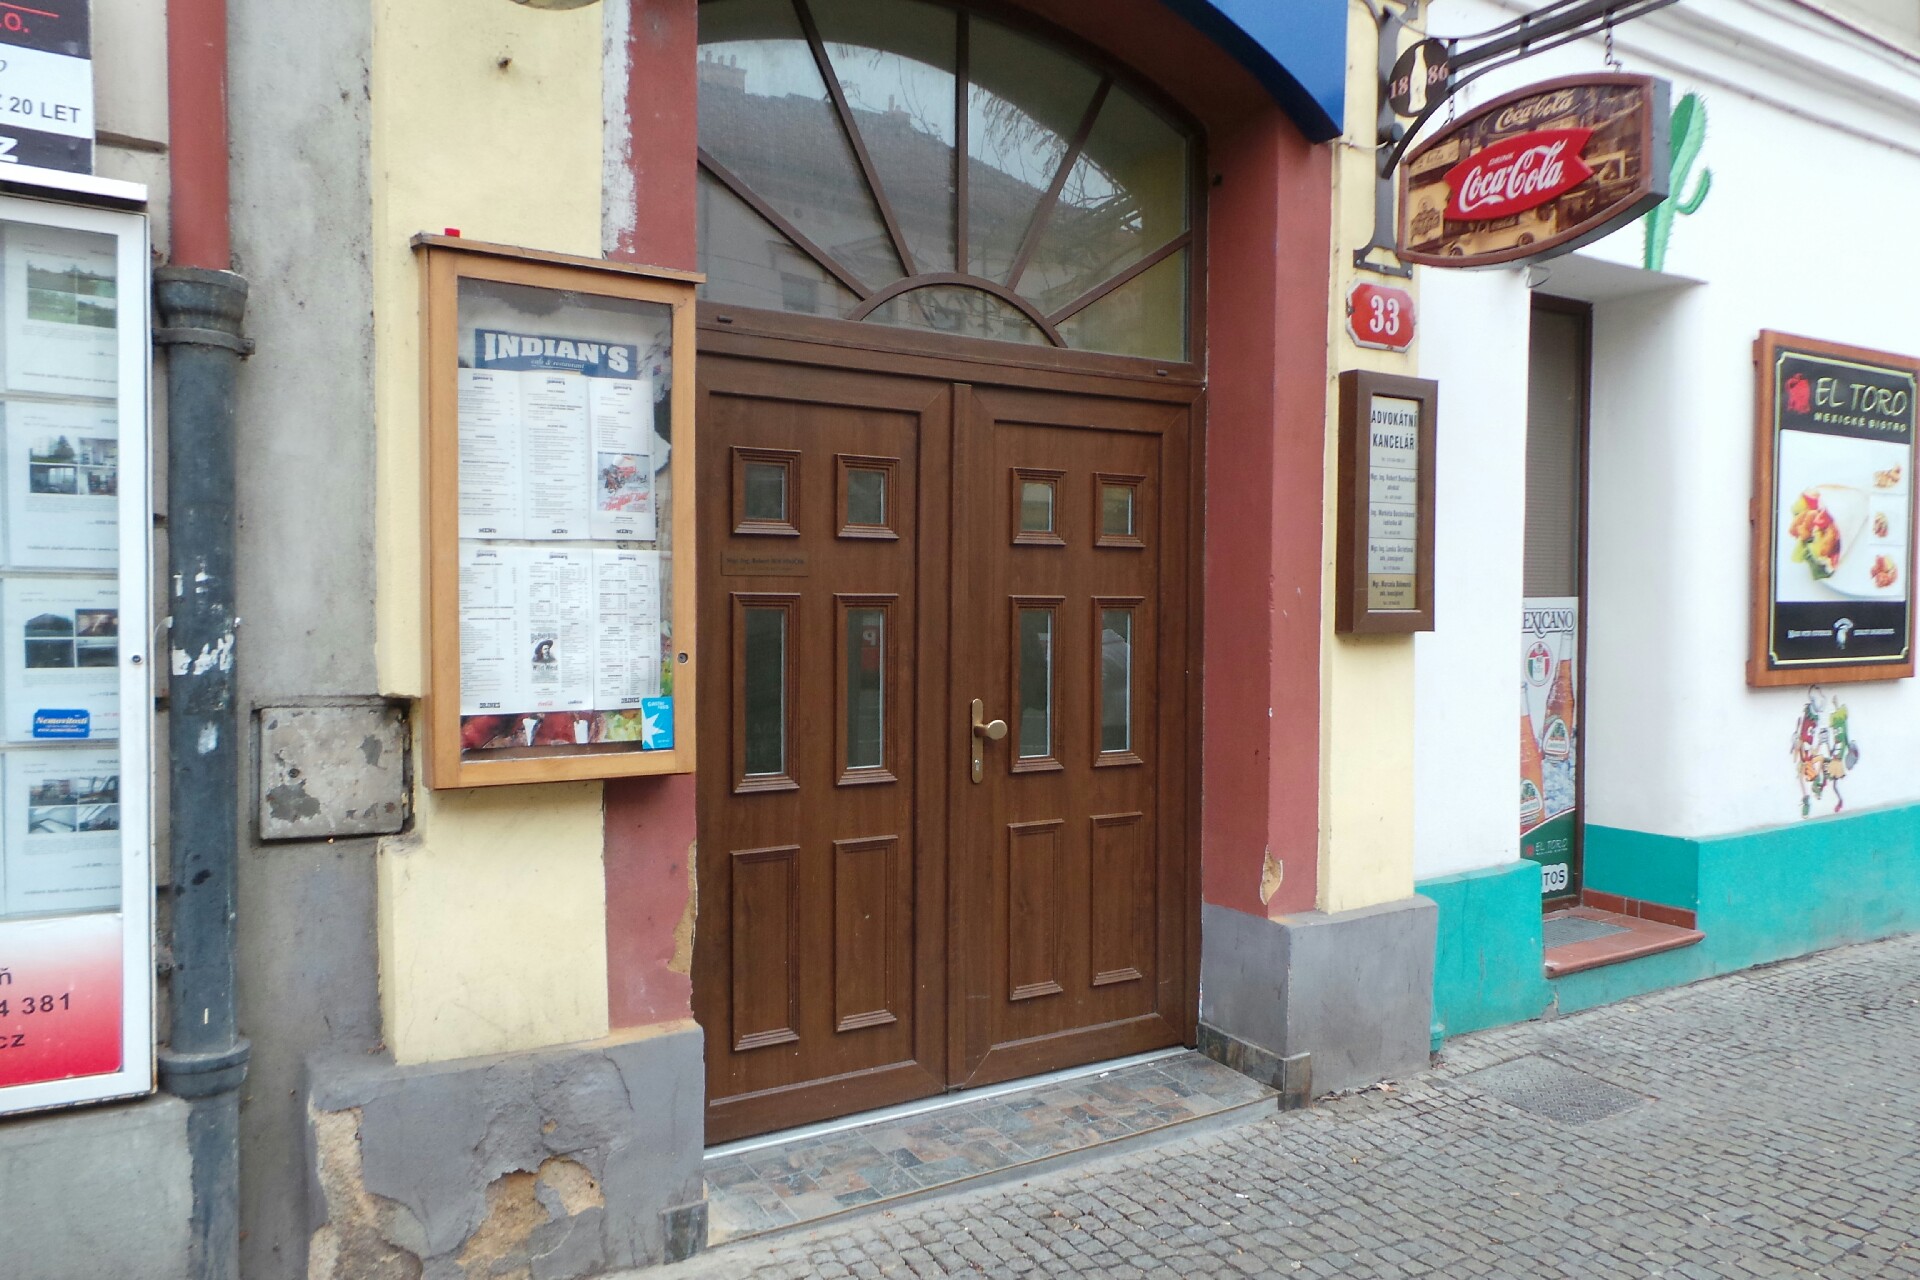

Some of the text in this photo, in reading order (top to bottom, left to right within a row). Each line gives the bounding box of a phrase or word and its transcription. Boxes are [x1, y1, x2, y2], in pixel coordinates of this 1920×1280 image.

[9, 96, 33, 115] 20
[41, 102, 81, 123] LET
[1458, 138, 1568, 212] Coca-Cola
[1369, 294, 1400, 336] 33
[484, 333, 629, 373] INDIAN'S
[1815, 377, 1908, 417] EL TORO
[1371, 409, 1418, 428] ADVOKÁTNÍ
[1814, 411, 1908, 433] MEXICKÉ BISTRO
[1372, 433, 1416, 451] KANCELÁŘ
[22, 992, 70, 1015] 381
